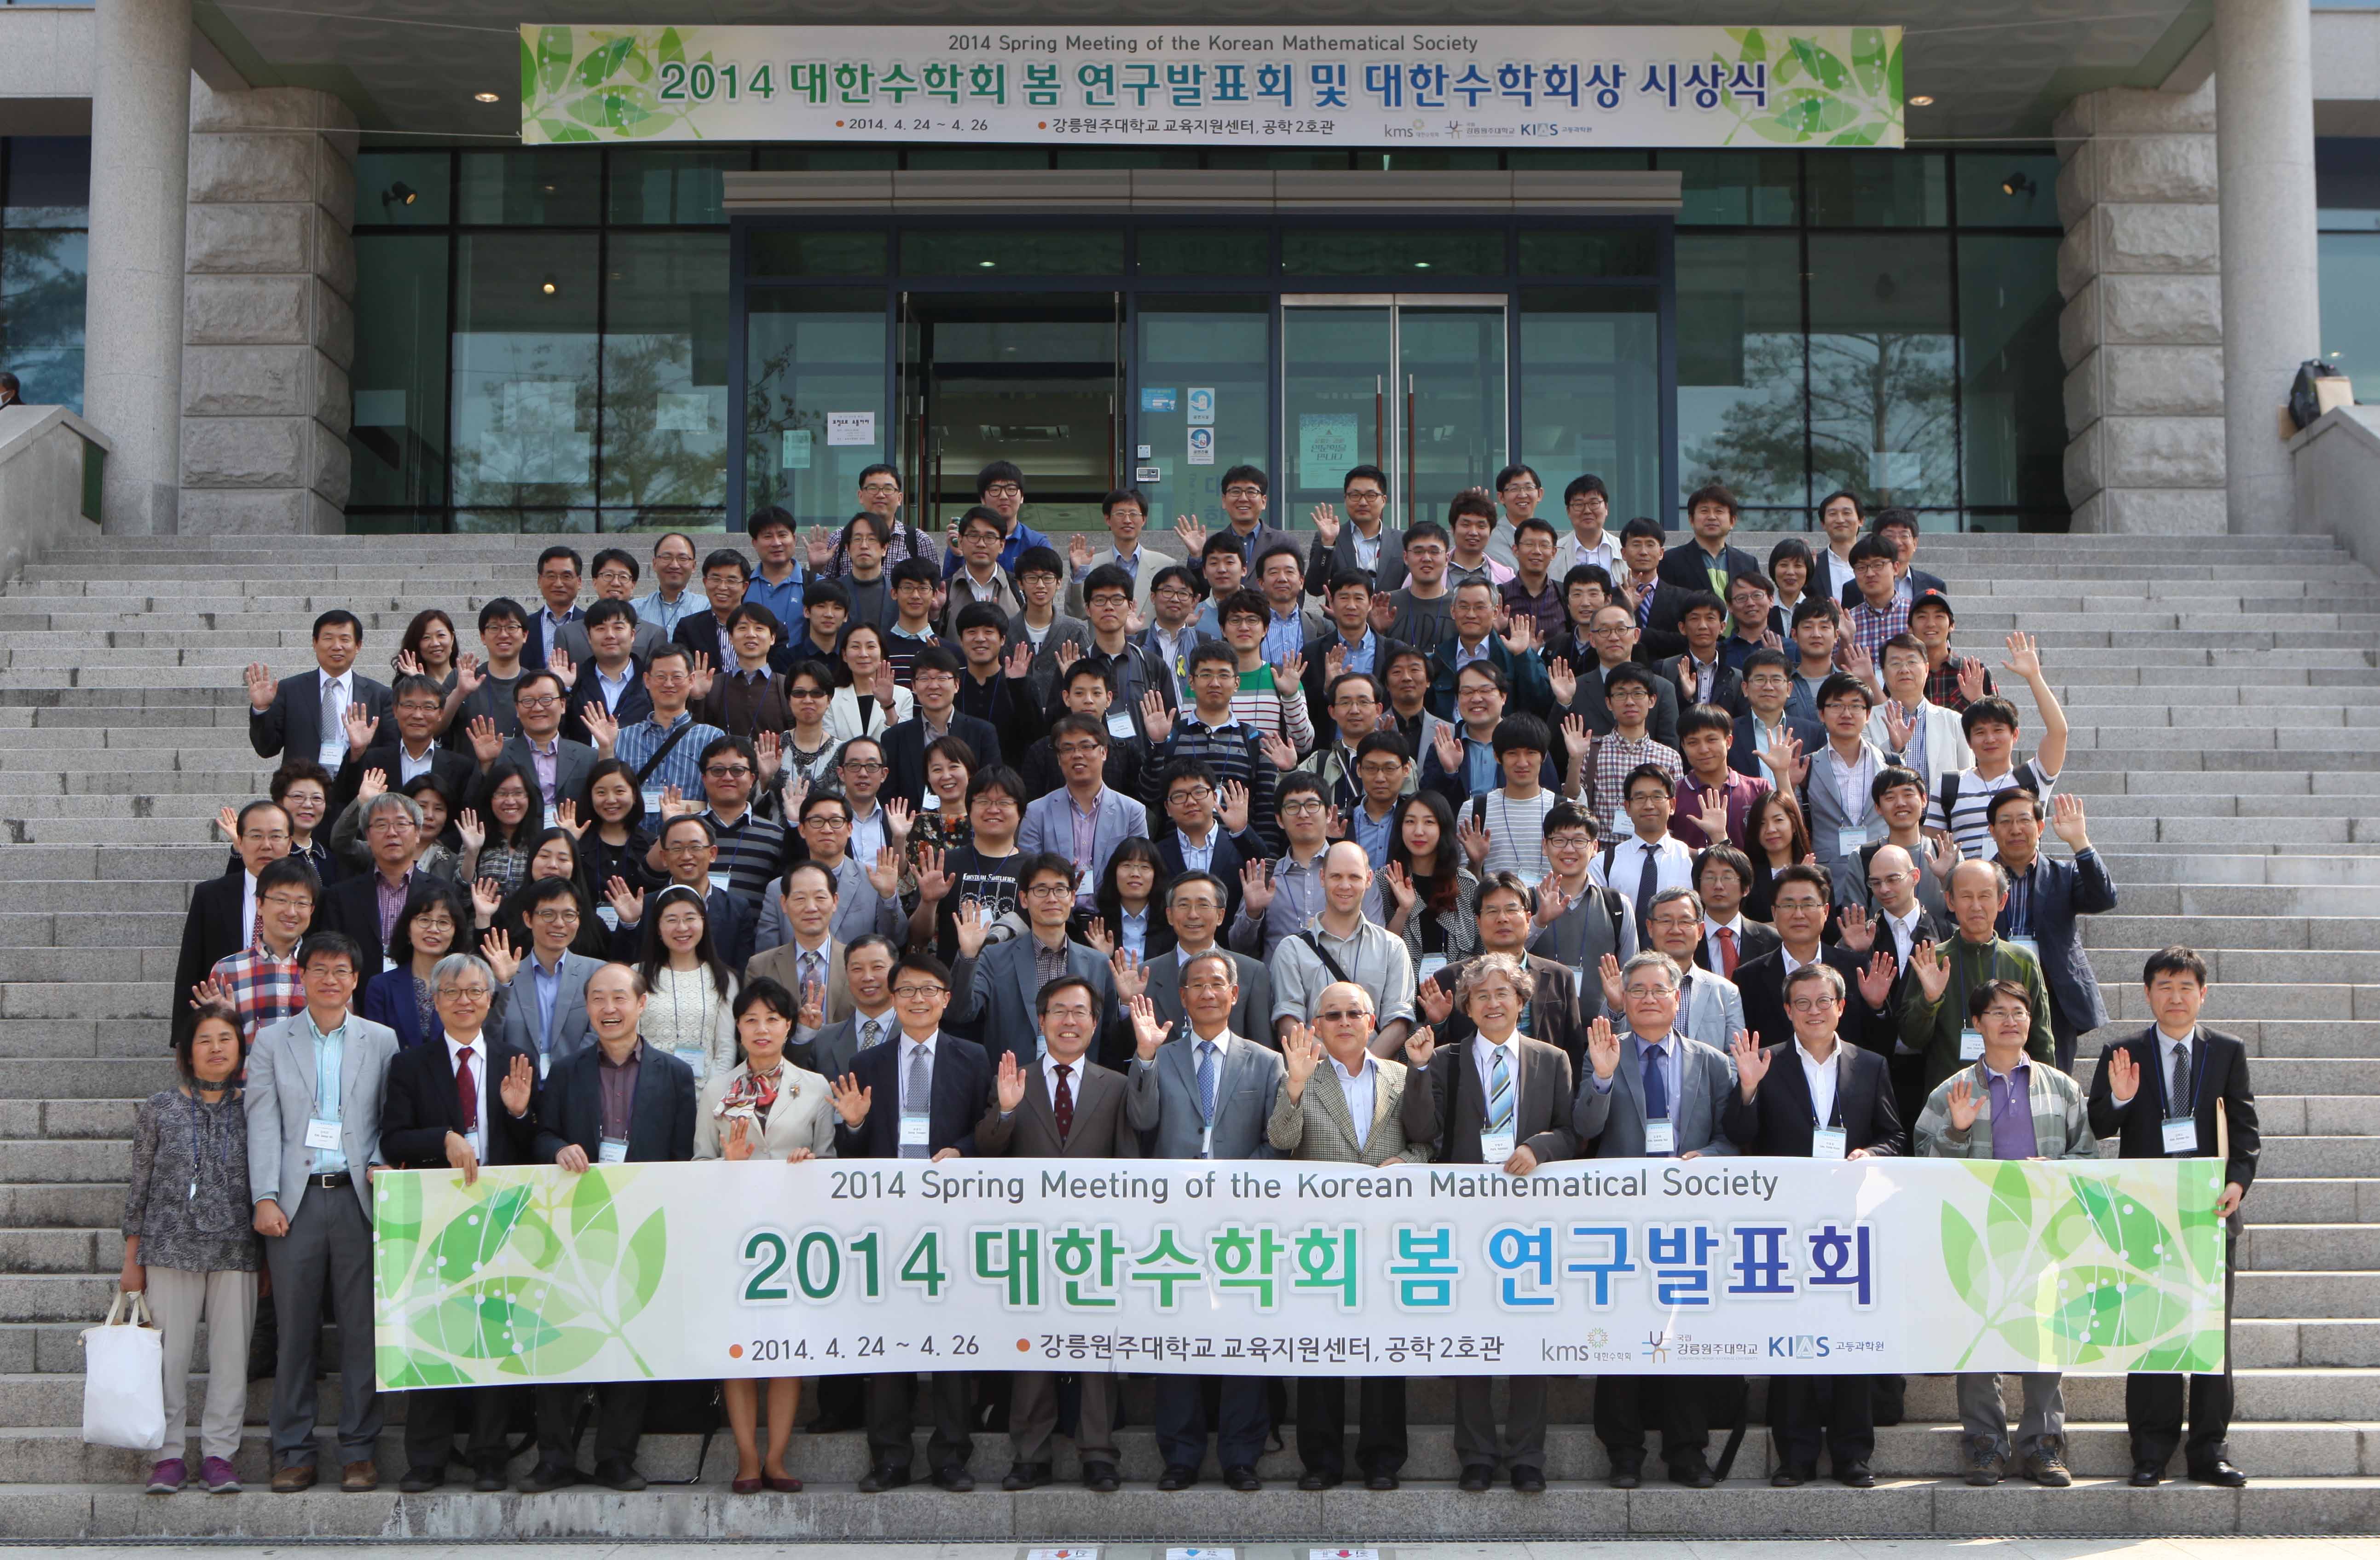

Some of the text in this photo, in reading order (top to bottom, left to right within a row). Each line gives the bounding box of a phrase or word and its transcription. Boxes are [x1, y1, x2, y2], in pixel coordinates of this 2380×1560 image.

[948, 35, 1478, 54] 2014 Spring Meeting of the Korean Mathematical Society
[660, 64, 1768, 109] 2014 대한수학회 봄 연구발표회 및 대한수학회상 시상식
[849, 119, 887, 130] 2014.
[894, 119, 907, 130] 4.
[913, 119, 930, 130] 24
[952, 119, 964, 131] 4.
[971, 119, 988, 131] 26
[1052, 118, 1160, 133] 강릉원주대학교
[1384, 124, 1413, 138] kms
[830, 1167, 1779, 1204] 2014 Spring Meeting of the Korean Mathematical Society
[744, 1225, 1872, 1308] 2014 대한수학회 봄 연구발표회
[751, 1338, 815, 1361] 2014.
[826, 1337, 846, 1358] 4.
[857, 1335, 885, 1357] 24
[920, 1335, 941, 1356] 4.
[952, 1335, 980, 1355] 26
[1040, 1334, 1216, 1360] 강릉원주대학교
[1221, 1336, 1380, 1363] 교육지원센터,
[1542, 1338, 1589, 1362] kms
[1677, 1343, 1758, 1355] 강릉원주대학교
[1768, 1336, 1831, 1358] KIAS
[1835, 1340, 1884, 1352] 고등과학원
